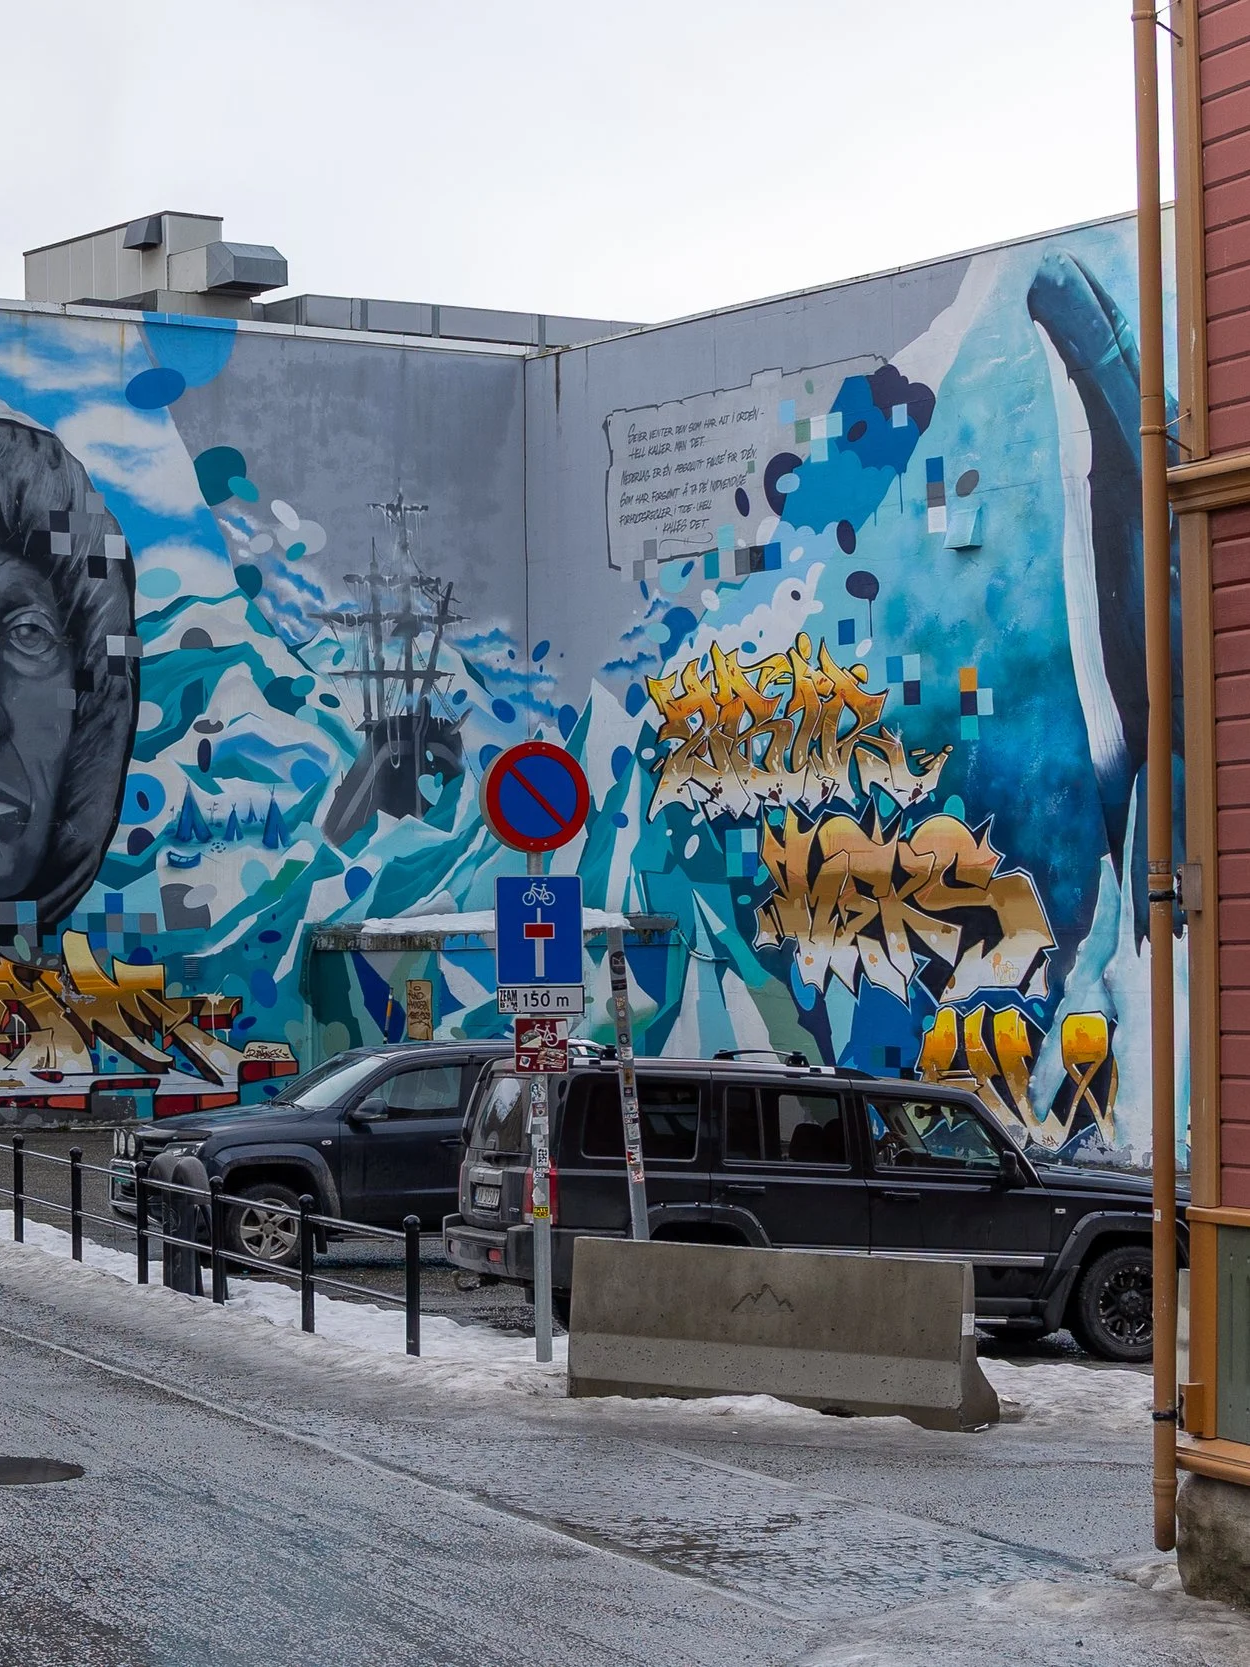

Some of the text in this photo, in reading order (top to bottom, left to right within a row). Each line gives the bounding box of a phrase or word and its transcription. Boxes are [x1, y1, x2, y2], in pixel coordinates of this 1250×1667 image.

[649, 427, 673, 440] VENTER
[675, 424, 687, 434] DEN
[688, 421, 702, 433] SOM
[704, 418, 717, 429] HAR
[719, 414, 729, 425] ALT
[736, 406, 760, 422] ORDEN
[629, 447, 646, 460] HELL
[648, 443, 672, 457] KALLER
[674, 440, 687, 452] MAN
[652, 467, 662, 479] ER
[635, 493, 650, 504] HAR
[662, 519, 687, 534] KALLES
[523, 993, 550, 1007] 150
[556, 996, 569, 1007] m
